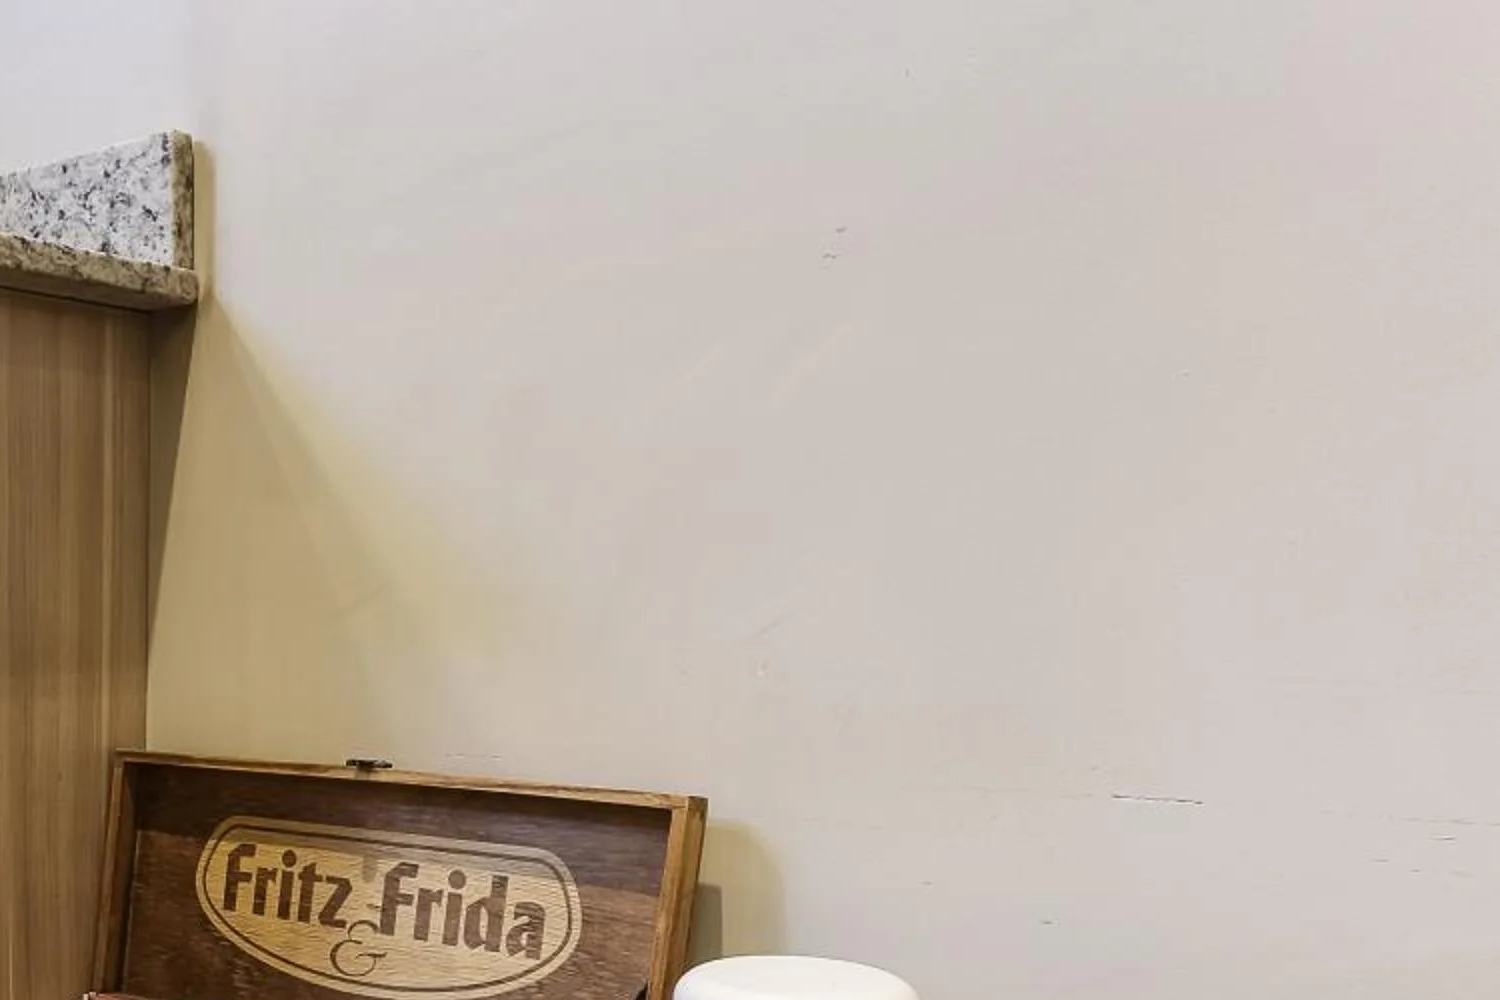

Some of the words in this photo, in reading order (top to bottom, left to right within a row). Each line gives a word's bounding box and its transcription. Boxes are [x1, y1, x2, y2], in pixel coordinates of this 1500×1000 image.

[222, 842, 353, 929] Fritz
[329, 919, 387, 977] &
[378, 861, 546, 961] Frida
